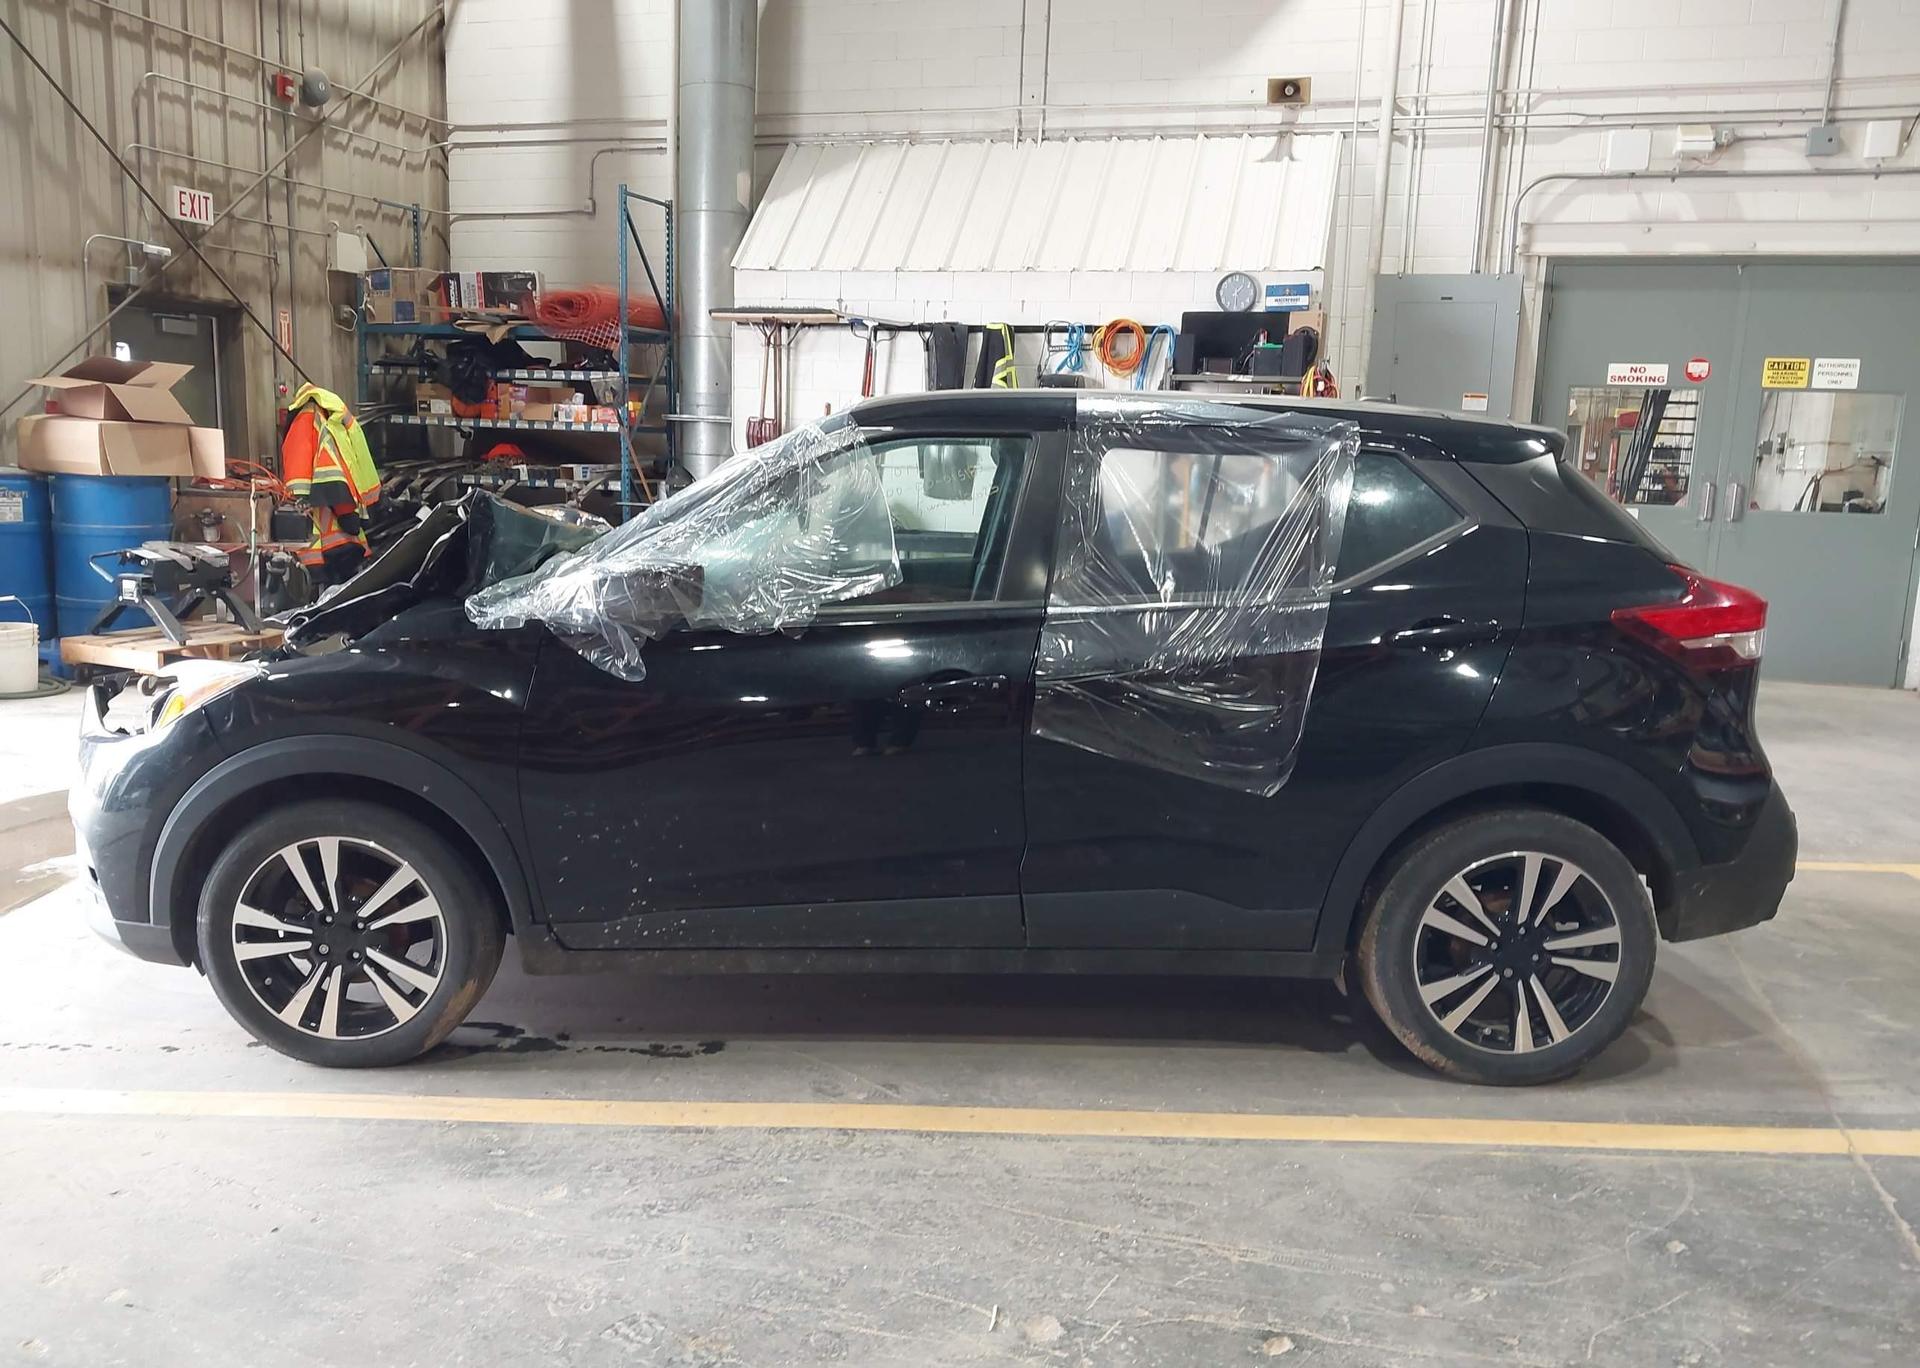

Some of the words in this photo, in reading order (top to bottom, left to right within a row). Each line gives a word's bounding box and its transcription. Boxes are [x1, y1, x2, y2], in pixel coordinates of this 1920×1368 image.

[179, 190, 210, 221] EXIT
[1629, 366, 1647, 374] NO
[1767, 361, 1806, 371] CAUTION
[1610, 375, 1665, 383] SMOKING
